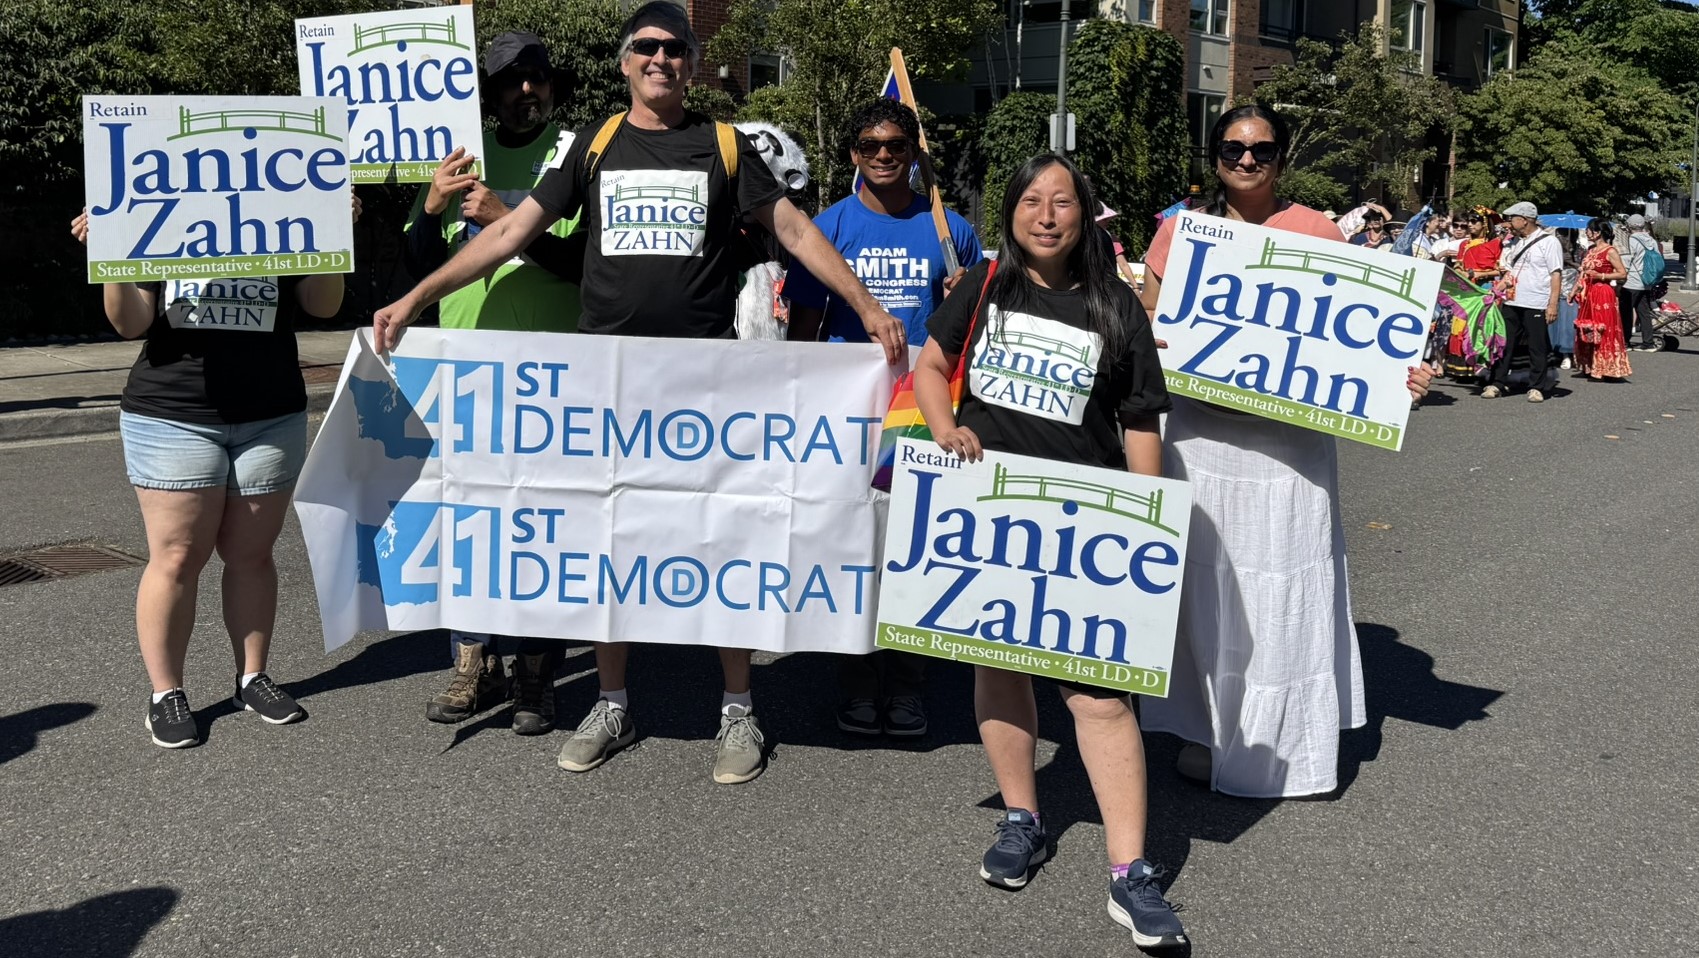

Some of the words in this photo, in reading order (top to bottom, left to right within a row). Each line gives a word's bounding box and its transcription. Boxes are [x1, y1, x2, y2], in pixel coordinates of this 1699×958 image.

[300, 24, 334, 38] Retain
[306, 40, 475, 105] Janice
[89, 102, 147, 117] Retain
[91, 123, 346, 216] Janice
[601, 174, 625, 188] Retain
[126, 193, 320, 259] Zahn
[603, 195, 705, 231] Janice
[1181, 216, 1234, 240] Retain
[613, 231, 694, 251] ZAHN
[859, 247, 907, 257] ADAM
[97, 261, 136, 278] State
[140, 258, 252, 278] Representative
[262, 255, 292, 270] 41st
[866, 279, 928, 287] CONGRESS
[167, 279, 277, 306] Janice
[1158, 238, 1423, 359] Janice
[180, 305, 265, 326] ZAHN
[972, 344, 1094, 389] Janice
[1177, 314, 1368, 419] Zahn
[404, 363, 494, 457] 41
[980, 373, 1074, 417] ZAHN
[1187, 377, 1295, 417] Representative
[1305, 407, 1335, 429] 41st
[513, 404, 882, 465] DEMOCRAT
[900, 445, 963, 469] Retain
[401, 506, 492, 600] 41
[887, 468, 1179, 594] Janice
[510, 550, 882, 615] DEMOCRAT
[915, 557, 1130, 664] Zahn
[884, 626, 925, 648] State
[930, 634, 1050, 669] Representative
[1063, 657, 1096, 678] 41st
